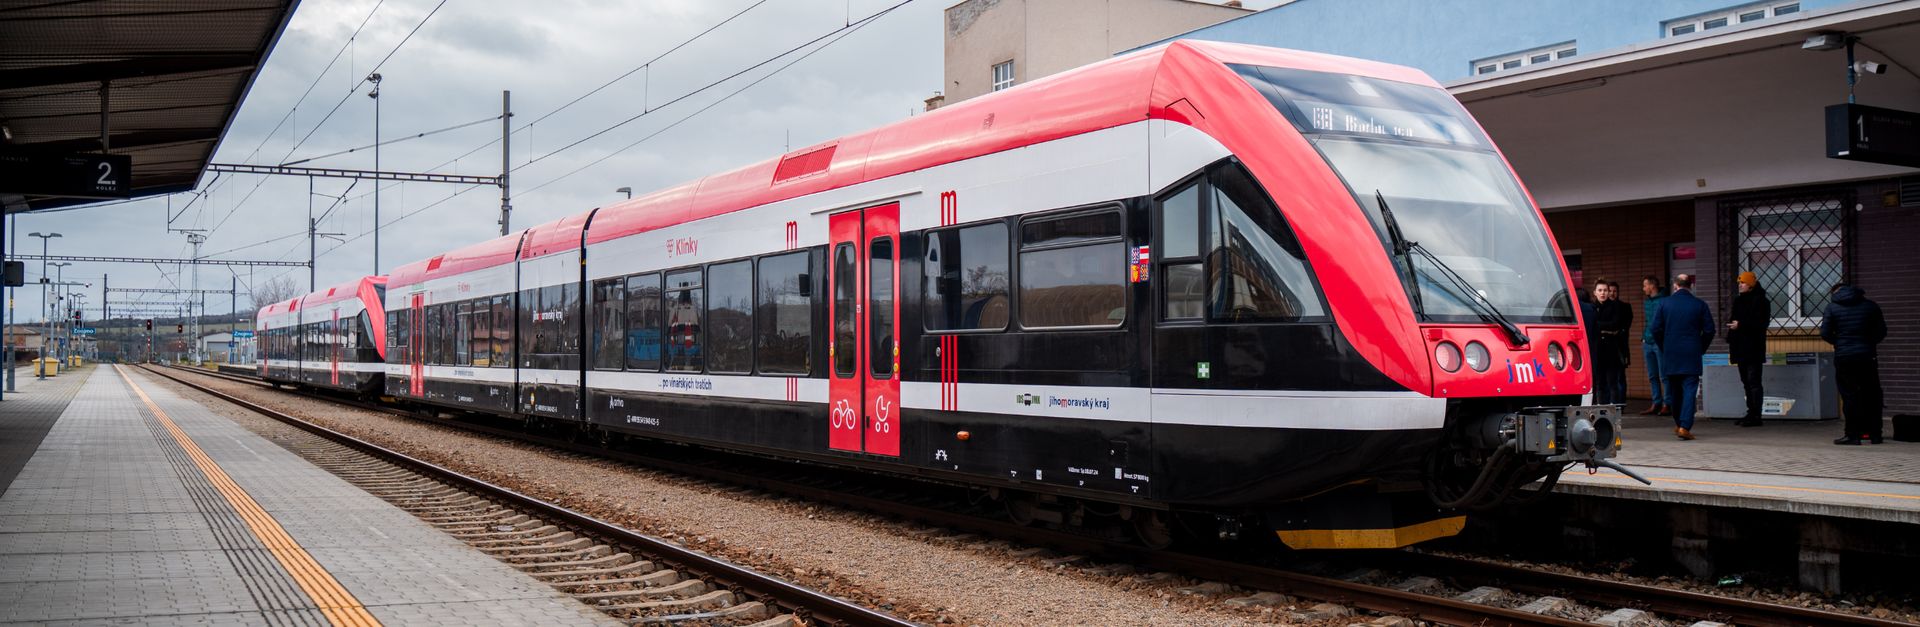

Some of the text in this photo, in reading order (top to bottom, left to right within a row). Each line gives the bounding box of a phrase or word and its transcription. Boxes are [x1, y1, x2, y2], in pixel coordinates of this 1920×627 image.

[1857, 114, 1868, 142] 1.
[97, 162, 116, 185] 2.
[1506, 358, 1545, 383] jmk
[1049, 396, 1110, 410] jihomoravský kraj
